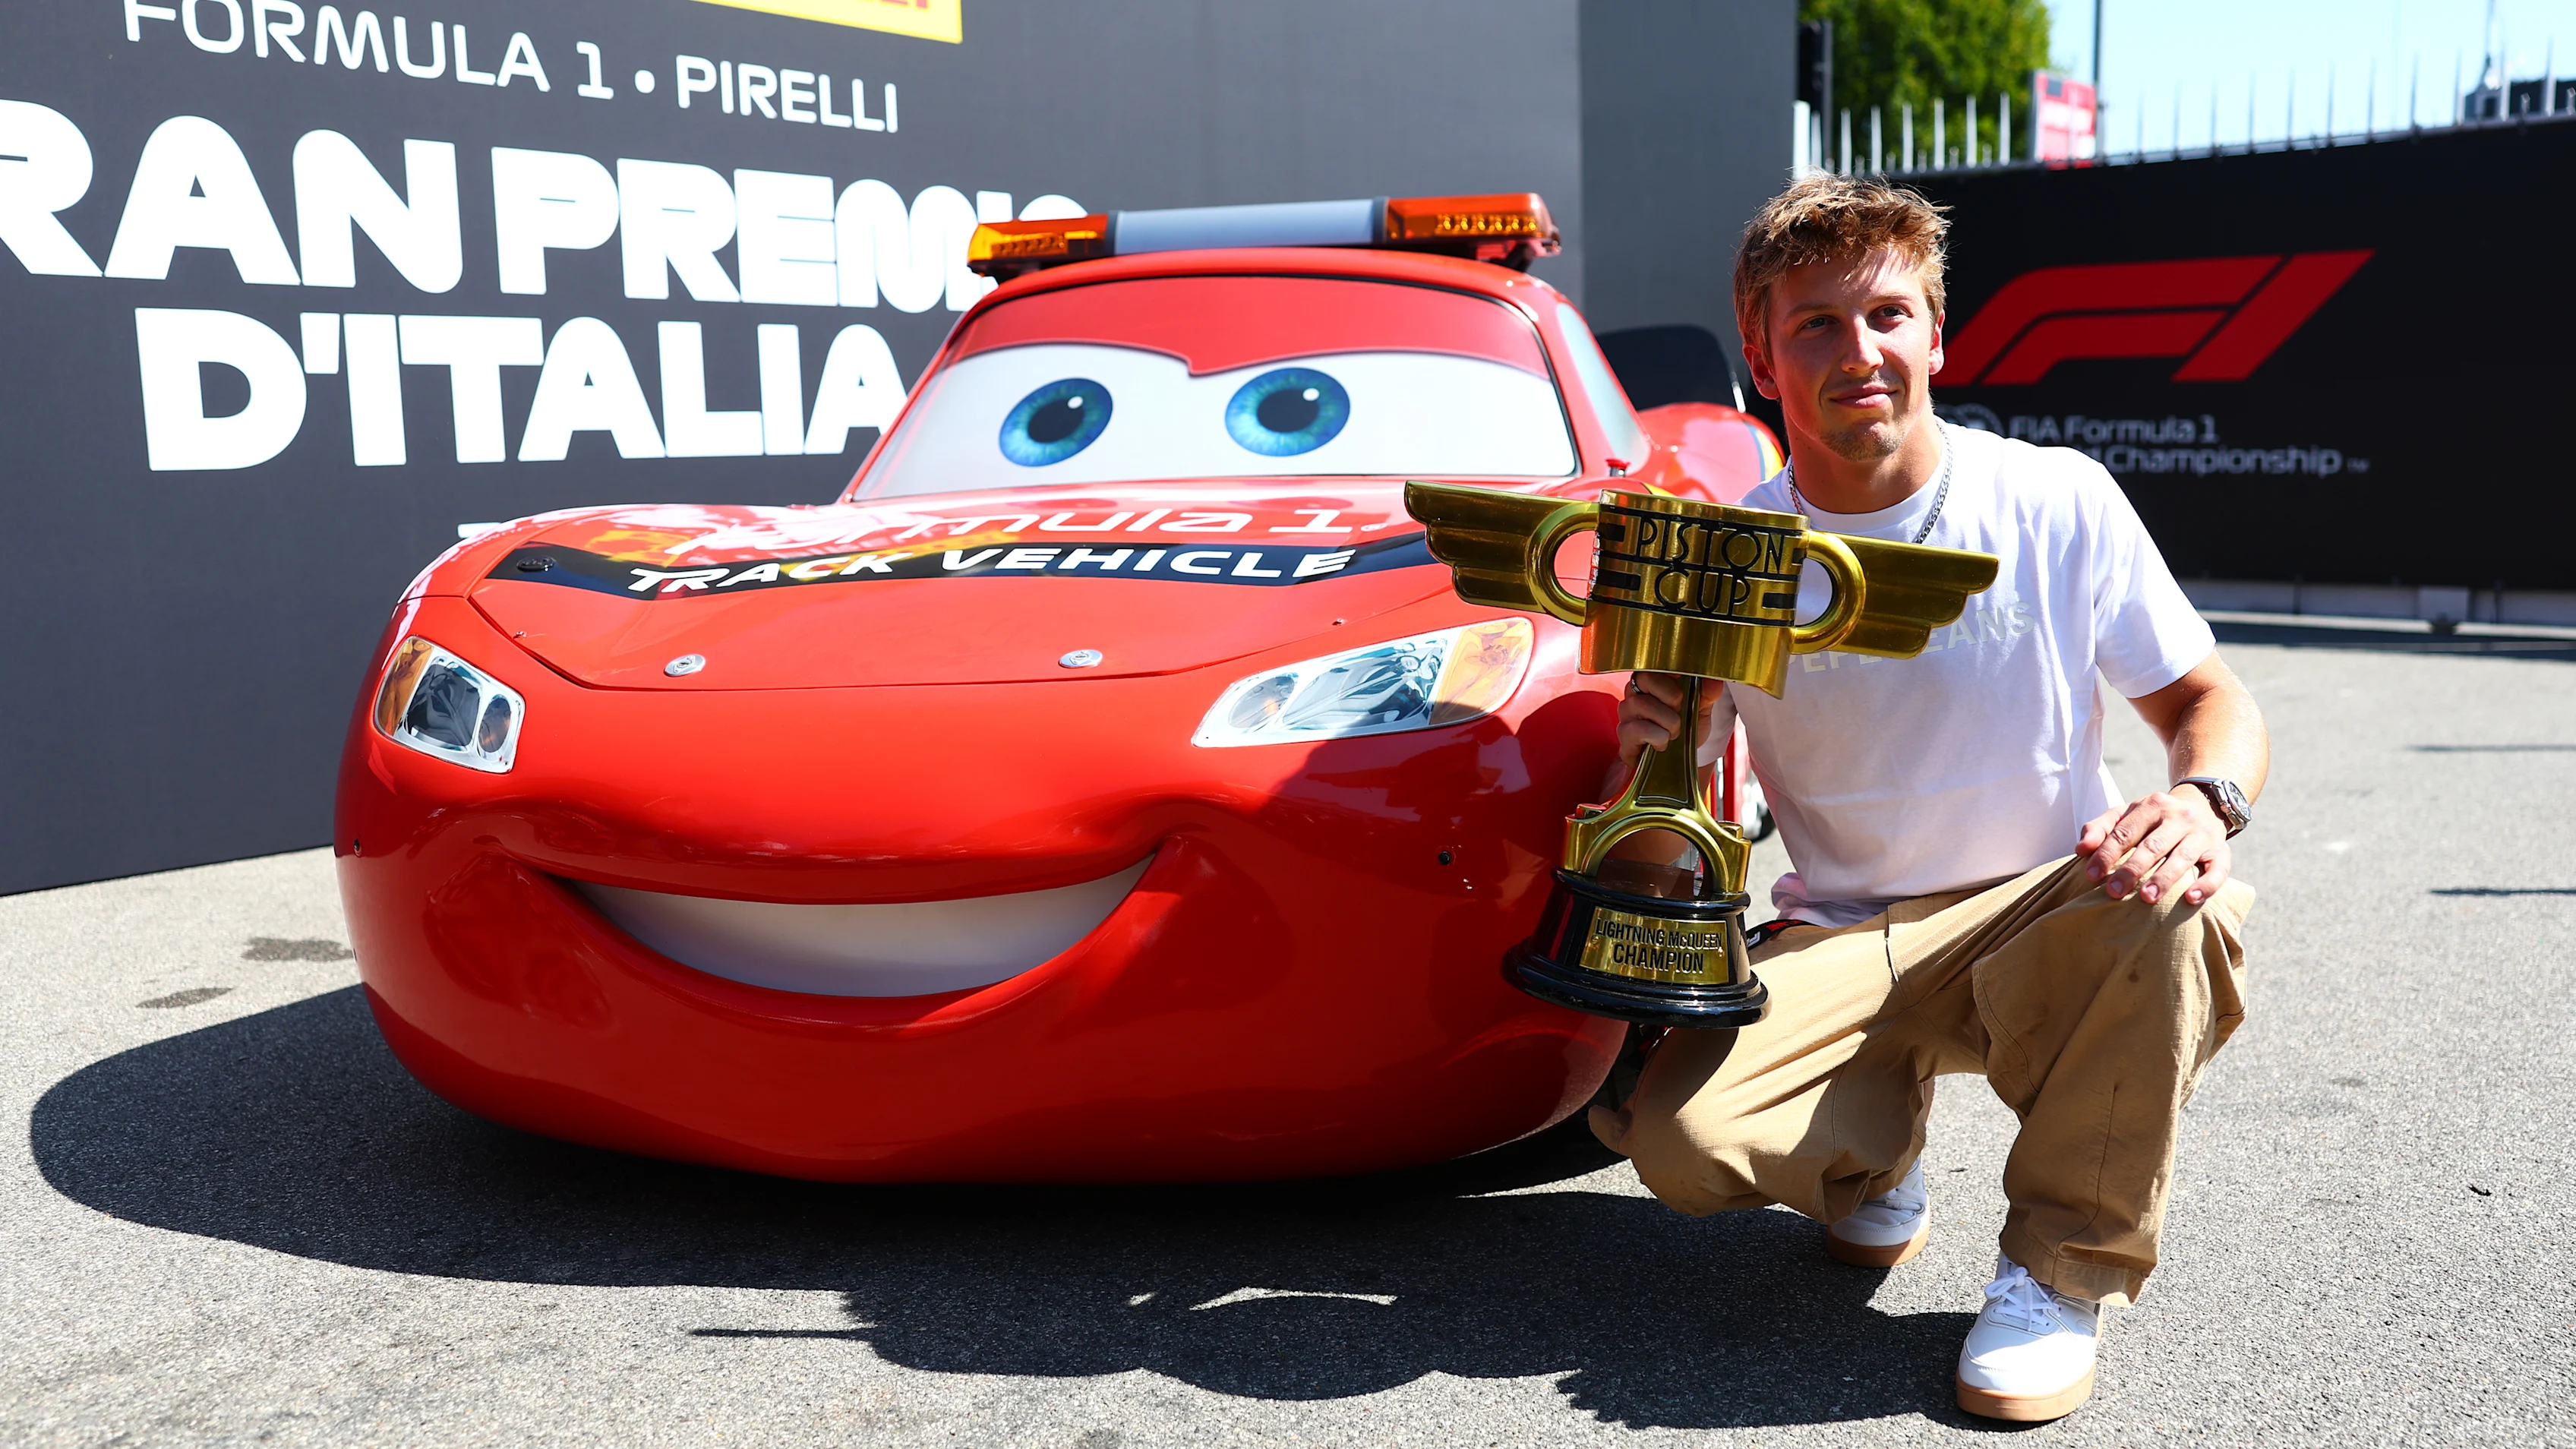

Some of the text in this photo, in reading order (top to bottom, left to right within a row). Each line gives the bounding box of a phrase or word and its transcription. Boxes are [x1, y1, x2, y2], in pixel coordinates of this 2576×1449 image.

[124, 0, 898, 133] FORMULA 1 PIRELLI
[491, 147, 1088, 313] PREM
[1930, 249, 2375, 386] F1
[134, 308, 909, 471] D'ITALIA
[2009, 414, 2218, 444] FIA Formula 1
[2104, 444, 2342, 477] Championship
[1636, 516, 1785, 576] PISTON
[627, 548, 1356, 593] TRACK VEHICLE
[1654, 570, 1750, 617] CUP
[1596, 918, 1665, 947] LIGHTNING
[1666, 933, 1723, 951] McQUEEN
[1613, 943, 1704, 974] CHAMPION
